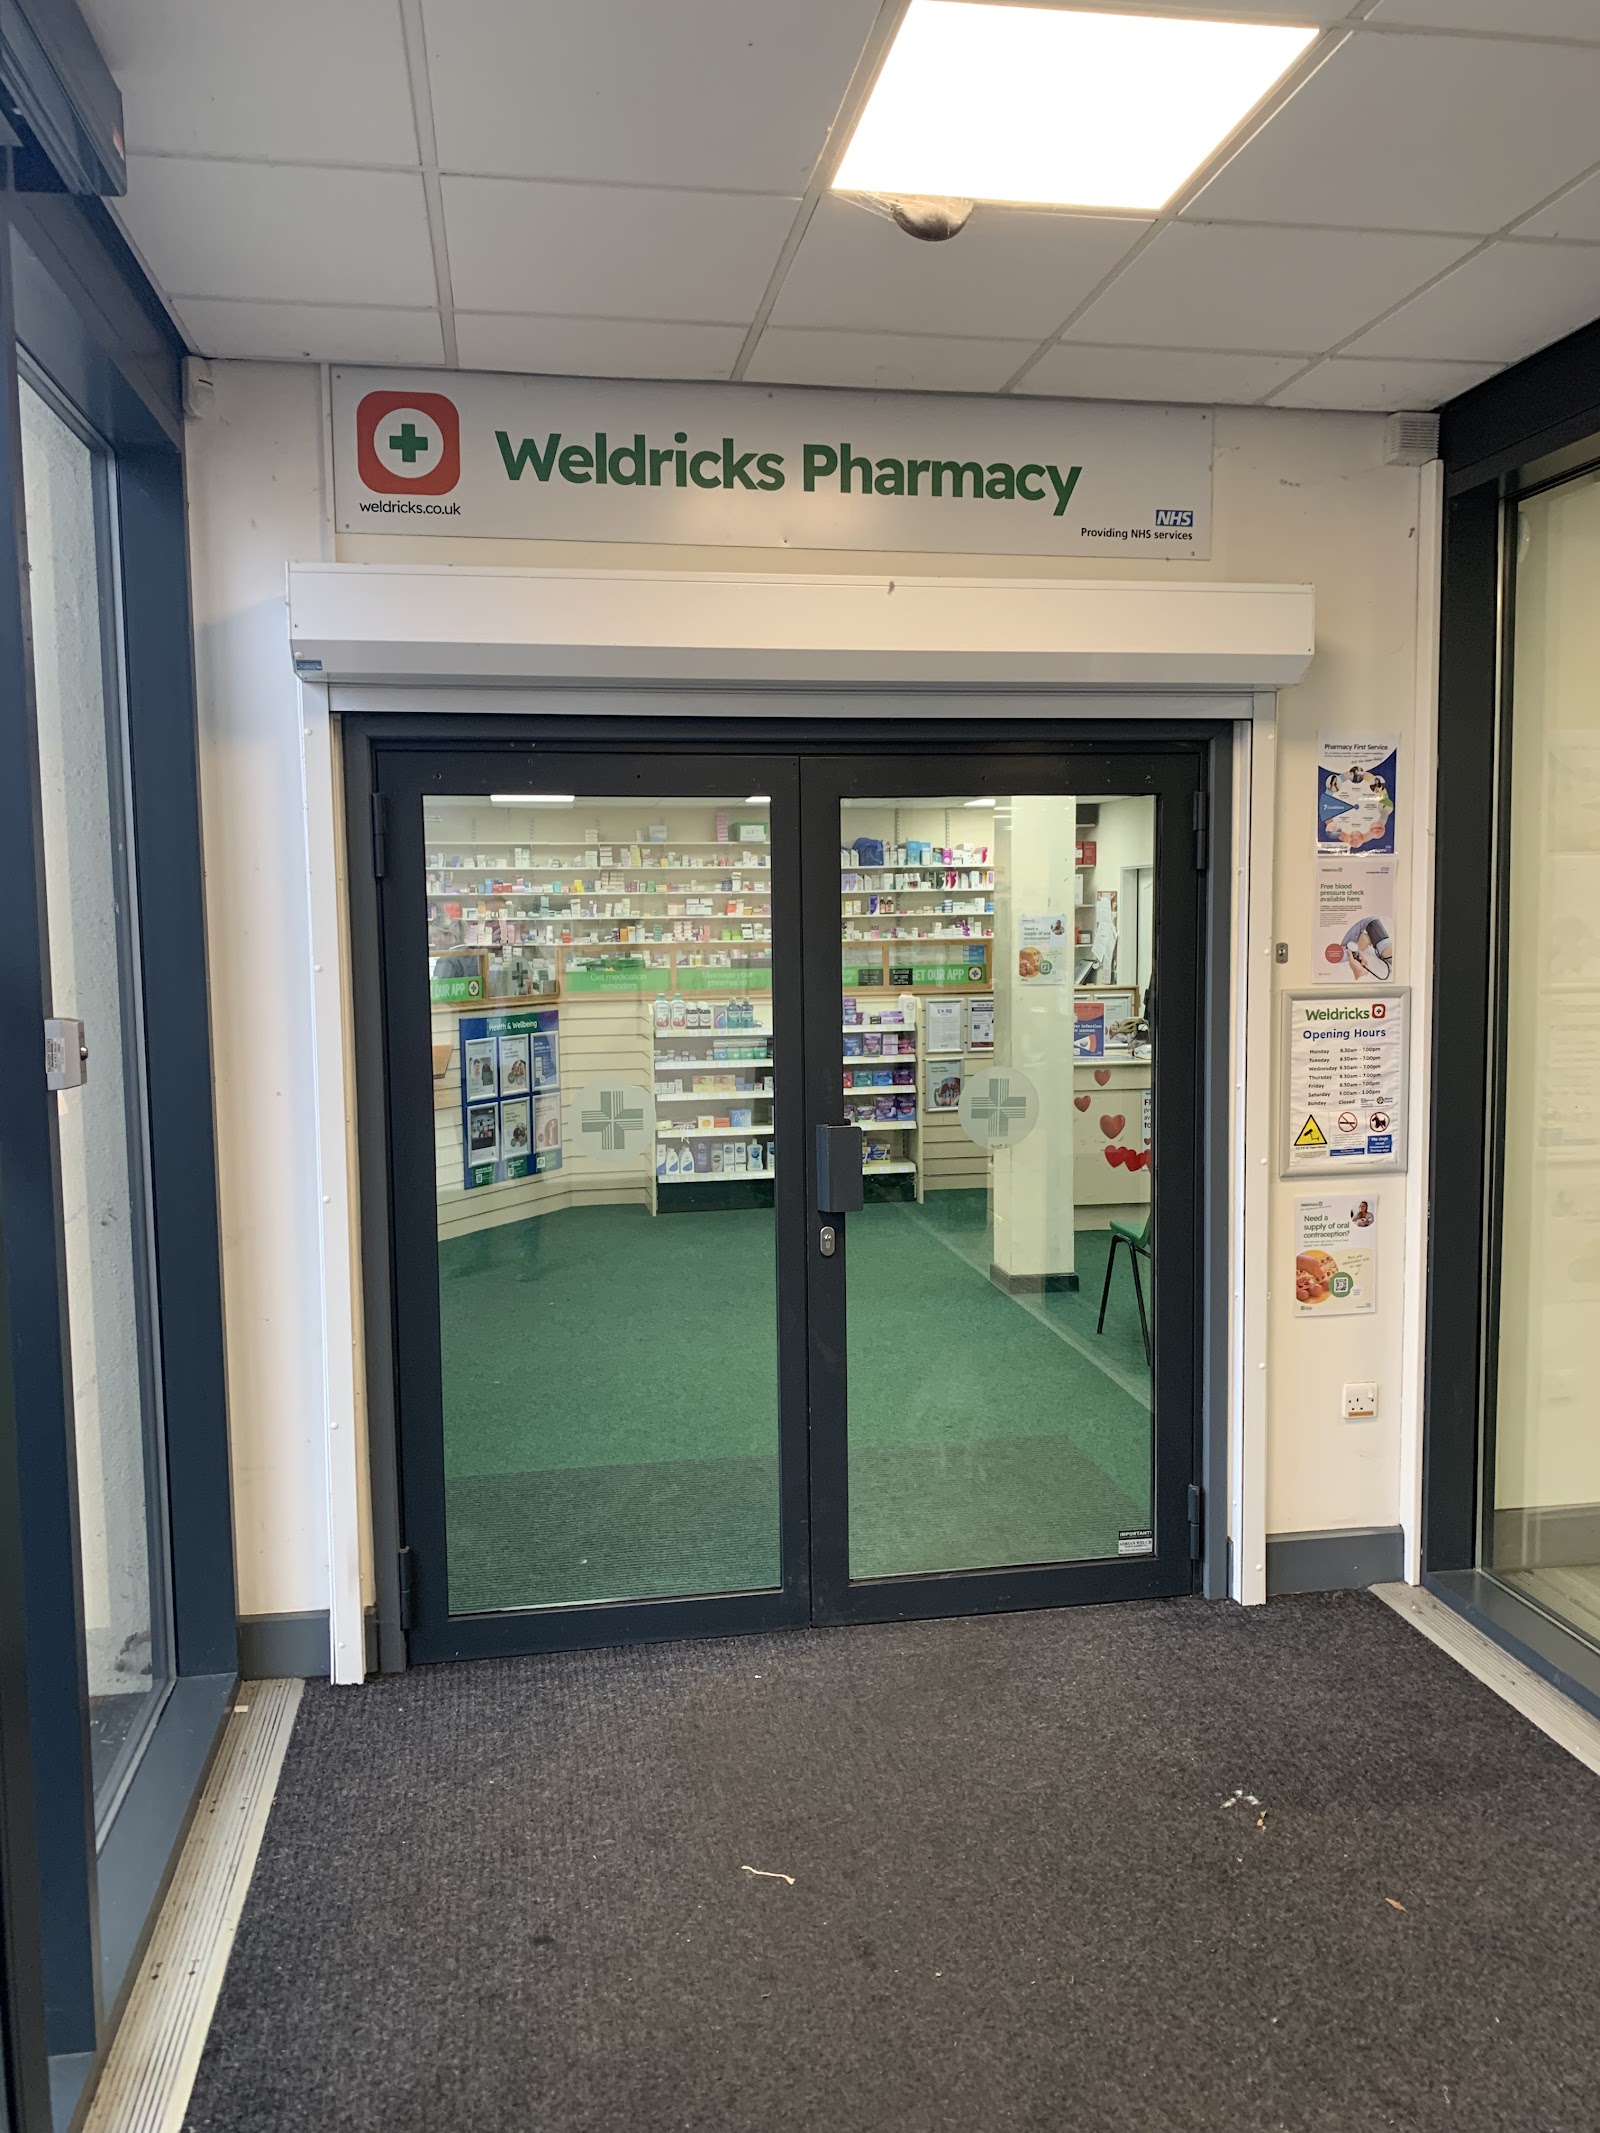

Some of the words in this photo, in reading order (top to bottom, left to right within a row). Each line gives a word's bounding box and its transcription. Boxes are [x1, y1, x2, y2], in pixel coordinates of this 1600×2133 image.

[494, 431, 785, 490] Weldricks
[803, 443, 1083, 516] Pharmacy
[359, 500, 462, 515] weldricks.co.uk
[1156, 510, 1193, 527] NHS
[1081, 527, 1128, 540] Providing
[1131, 529, 1152, 539] NHS
[1154, 530, 1193, 540] services
[590, 973, 604, 981] Get
[928, 969, 946, 980] OUR
[947, 968, 964, 980] APP
[434, 984, 450, 998] OUR
[451, 982, 466, 996] APP
[1305, 1007, 1370, 1020] Weldricks
[489, 1023, 506, 1031] Health
[512, 1020, 537, 1028] Wellbeing
[1303, 1028, 1350, 1041] Opening
[1354, 1028, 1386, 1038] Hours
[1304, 1223, 1326, 1231] supply
[1304, 1230, 1350, 1238] contraception?
